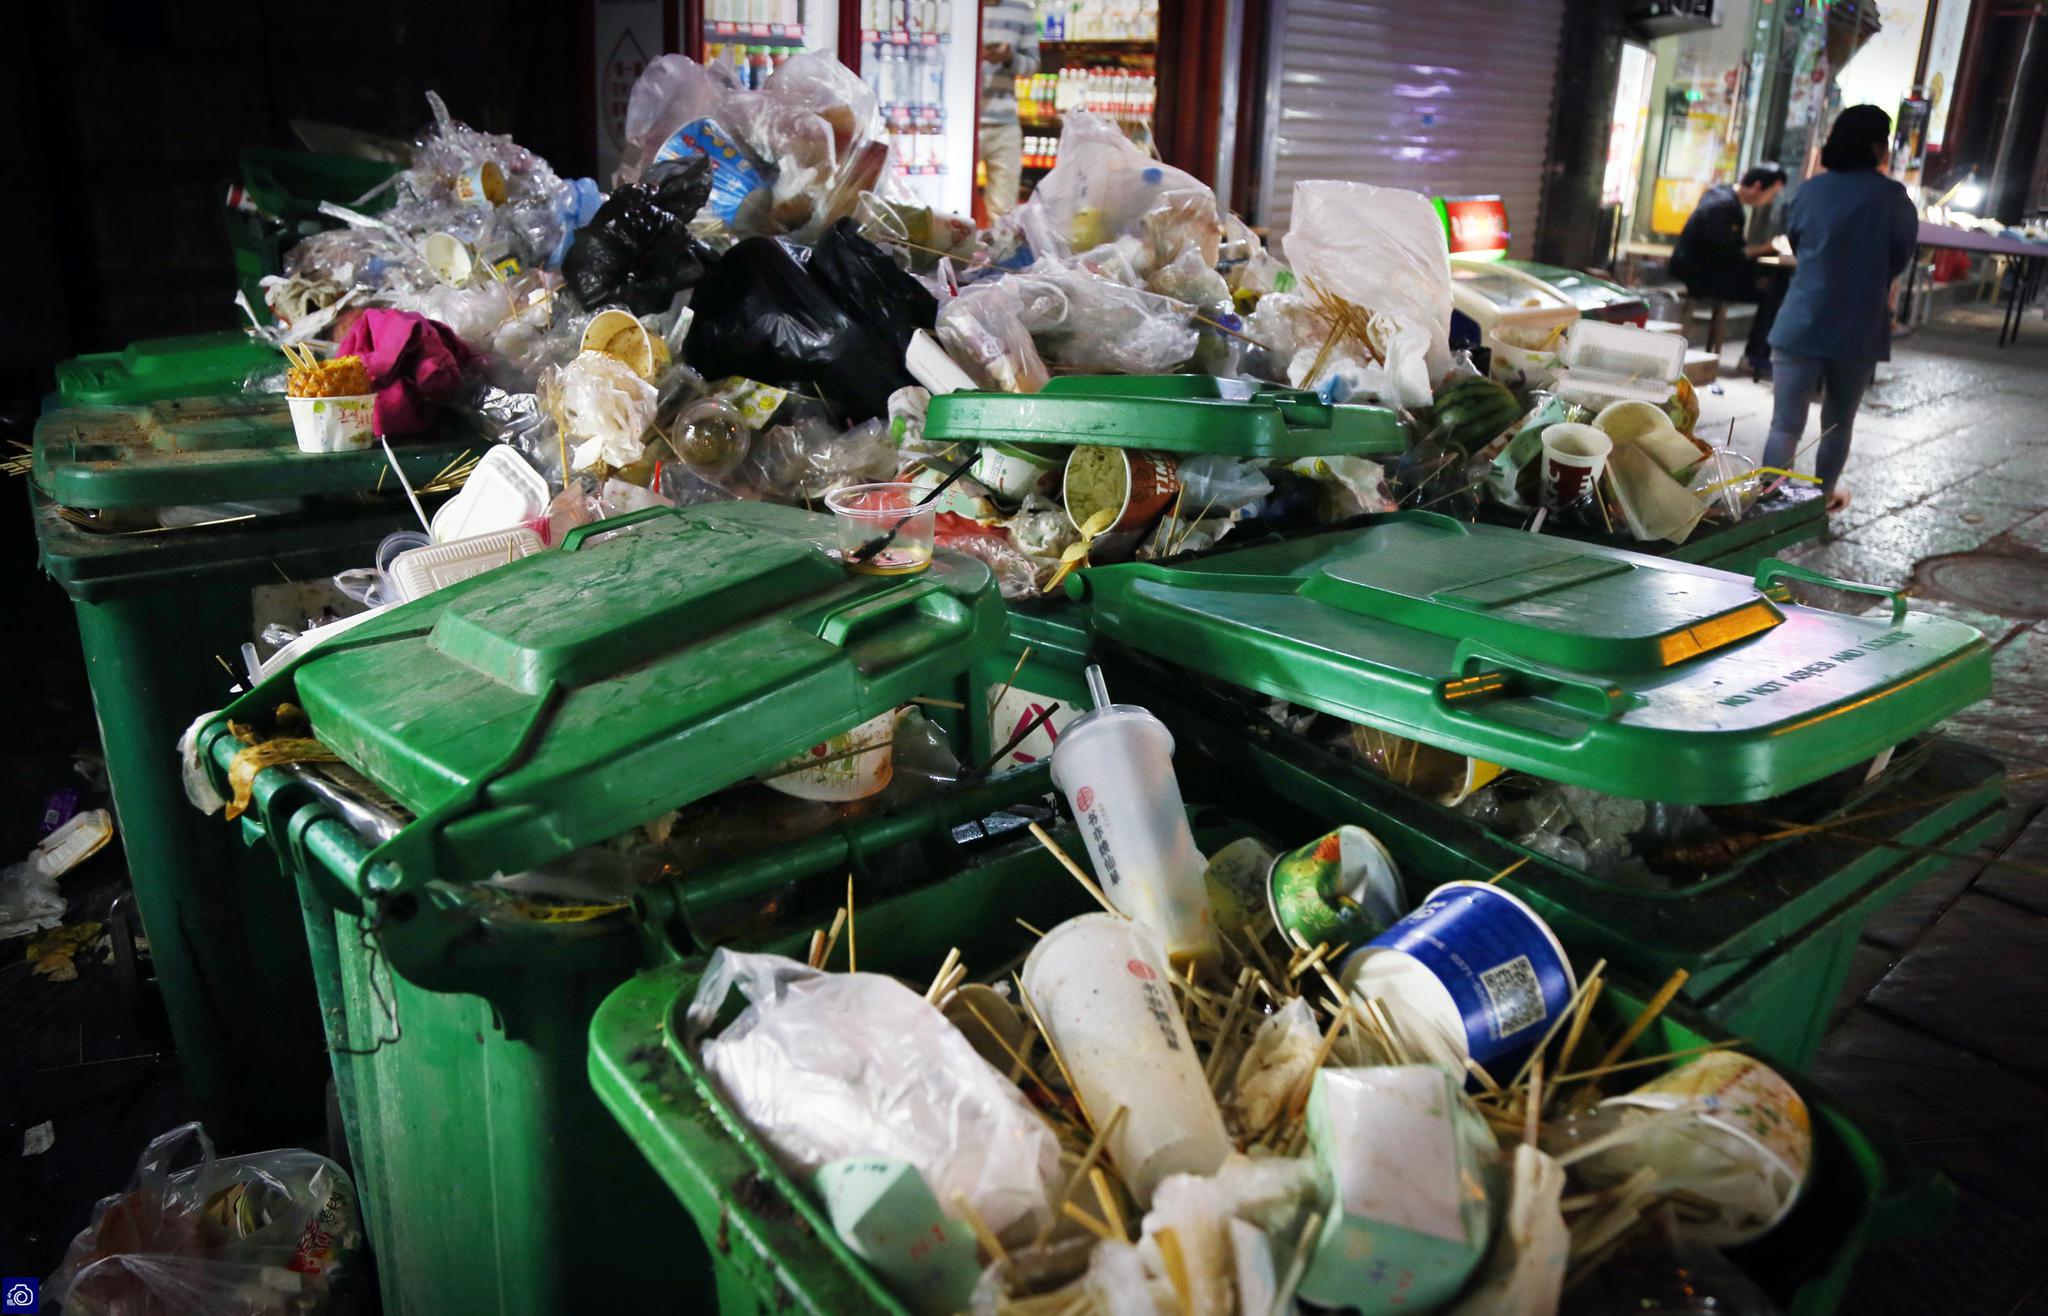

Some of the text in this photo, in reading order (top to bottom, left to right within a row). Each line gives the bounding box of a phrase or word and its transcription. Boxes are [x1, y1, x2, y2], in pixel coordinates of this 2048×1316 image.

[1718, 695, 1756, 707] NO
[1746, 680, 1788, 697] HOT
[1783, 661, 1836, 682] ASHES
[1829, 649, 1866, 663] AND
